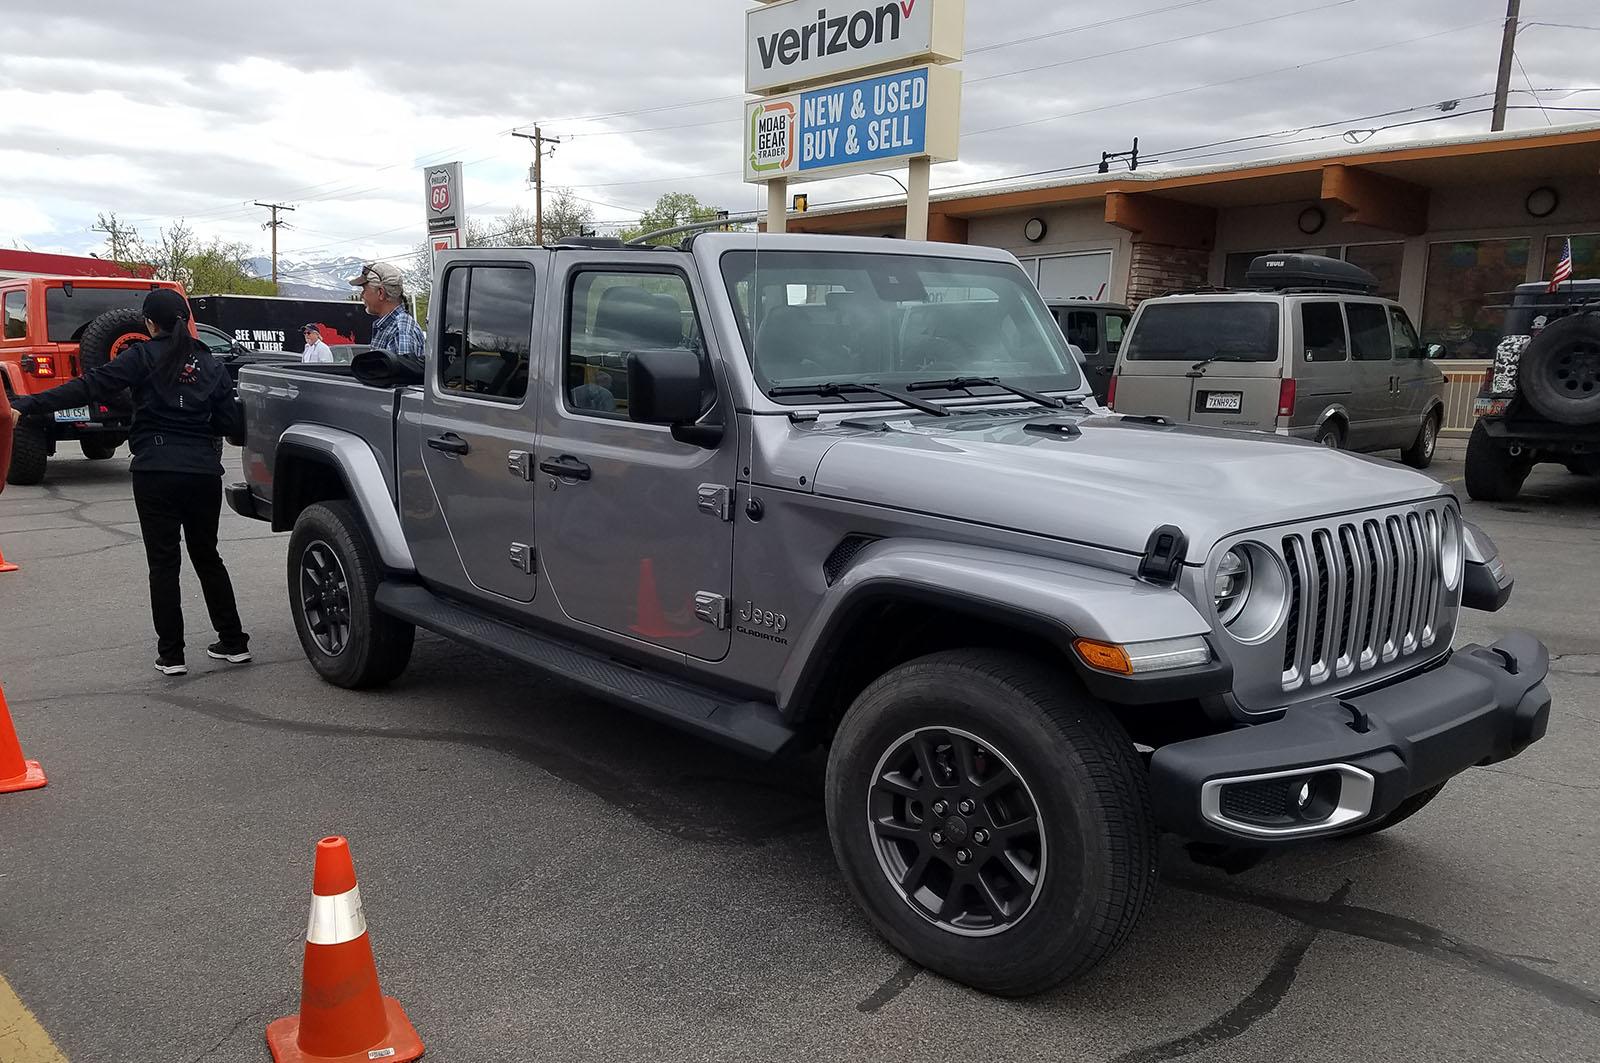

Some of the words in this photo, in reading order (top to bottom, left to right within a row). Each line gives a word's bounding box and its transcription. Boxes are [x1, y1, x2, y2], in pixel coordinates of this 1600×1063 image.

[757, 2, 900, 69] verizon
[804, 93, 844, 128] NEW
[851, 89, 866, 119] &
[873, 77, 925, 115] USED
[759, 115, 785, 133] MOAB
[759, 131, 785, 150] GEAR
[803, 128, 839, 161] BUY
[845, 125, 859, 154] &
[868, 115, 913, 151] SELL
[758, 147, 785, 158] TRADER
[433, 187, 446, 204] 66
[235, 329, 250, 340] SEE
[253, 330, 285, 341] WHAT'S
[259, 341, 284, 351] THERE
[1209, 397, 1238, 407] 7XNH925
[739, 600, 787, 634] Jeep
[736, 625, 788, 645] GLADIATOR
